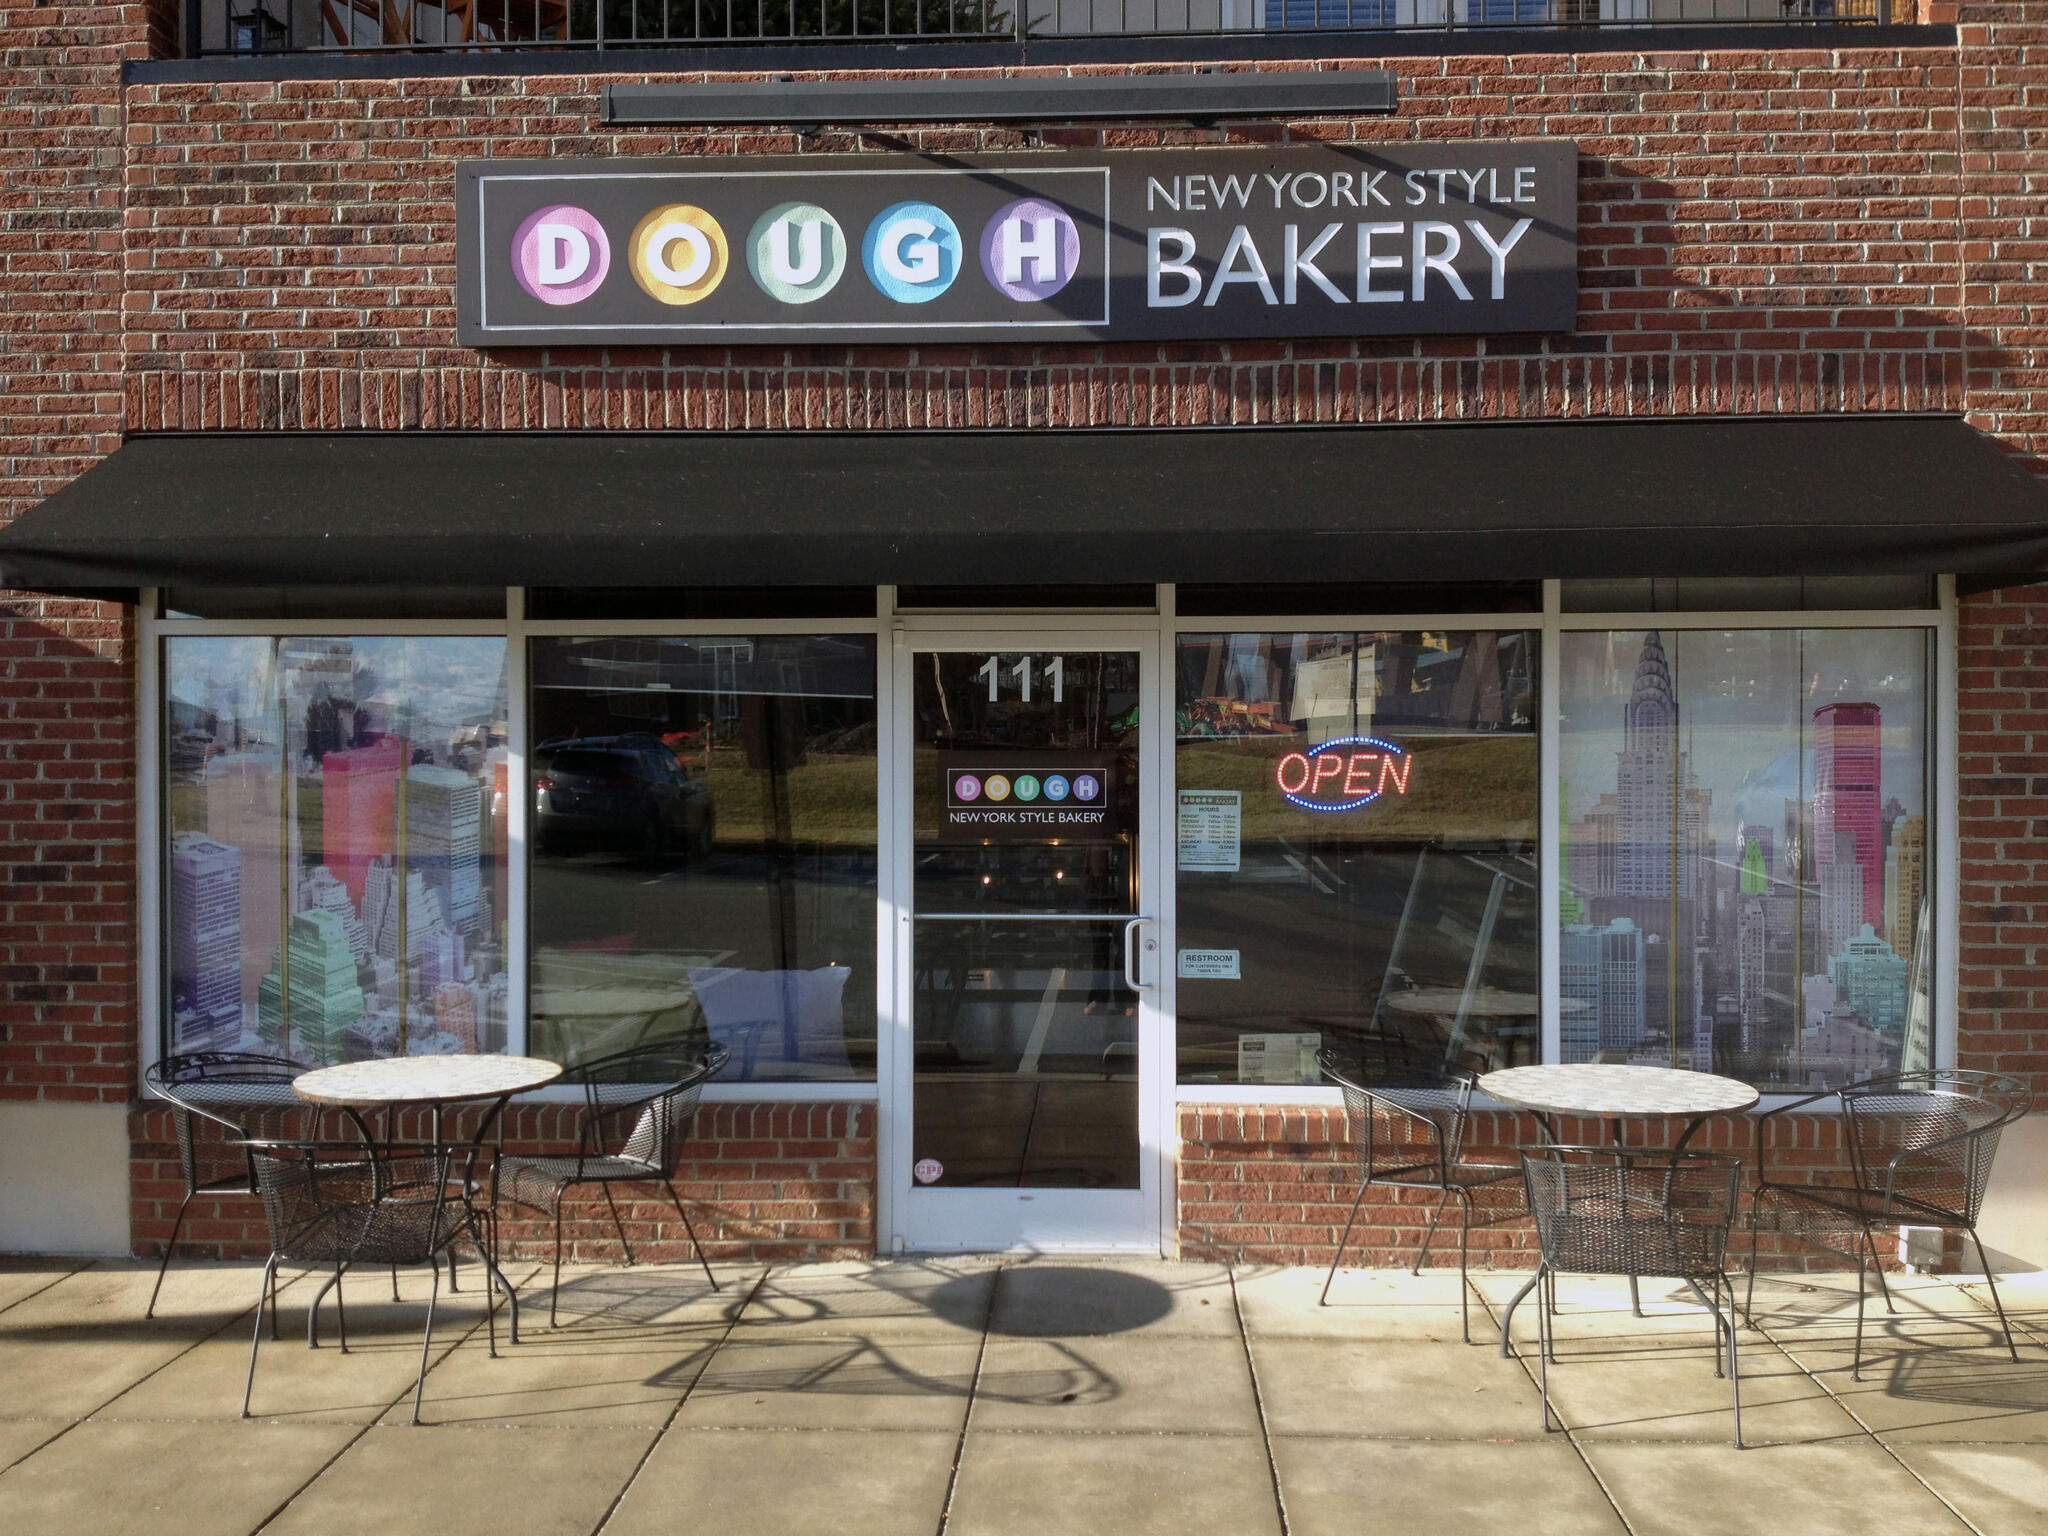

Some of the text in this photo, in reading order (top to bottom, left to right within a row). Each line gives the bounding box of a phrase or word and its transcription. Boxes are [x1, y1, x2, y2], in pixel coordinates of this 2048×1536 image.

[1147, 167, 1535, 211] NEW YORK STYLE
[537, 217, 1057, 287] DOUGH
[1147, 218, 1533, 307] BAKERY
[979, 656, 1063, 702] 111
[962, 779, 1094, 797] DOUGH
[1276, 752, 1413, 794] OPEN
[950, 812, 1105, 823] NEW YORK STYLE BAKERY
[1185, 954, 1233, 962] RESTROOM
[916, 1165, 942, 1175] CPI
